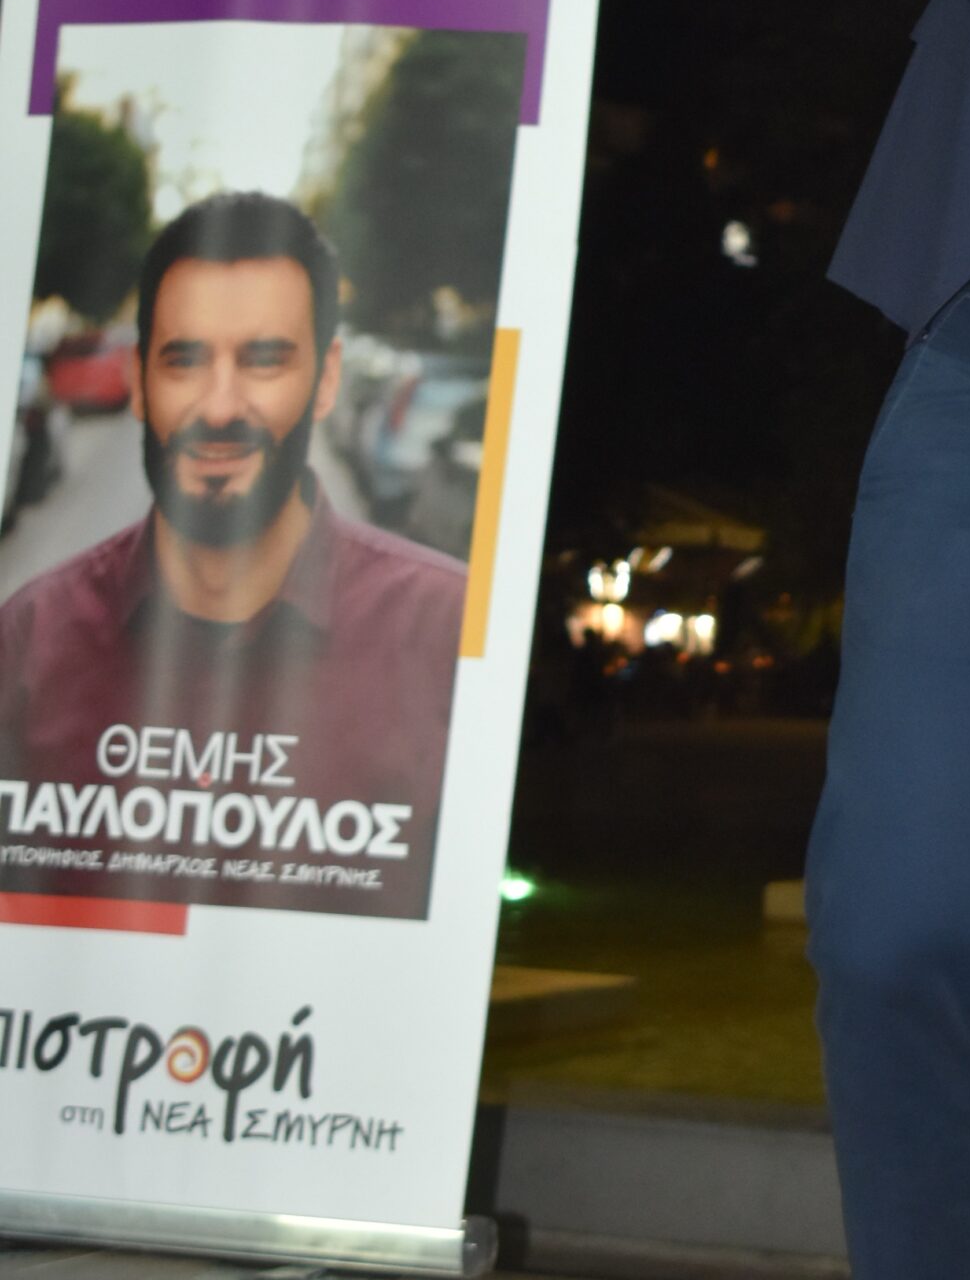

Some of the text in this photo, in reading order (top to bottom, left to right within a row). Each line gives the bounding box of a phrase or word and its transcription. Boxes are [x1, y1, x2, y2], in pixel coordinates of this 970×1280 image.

[97, 724, 299, 787] ΘΕΜΗΣ
[0, 779, 413, 858] ΠΑΥΛΟΠΟΥΛΟΣ
[221, 859, 276, 882] ΝΕΑΣ
[279, 862, 384, 891] ΣΜΥΡΝΗΣ
[139, 1100, 213, 1139] ΝΕΑ
[240, 1108, 405, 1153] ΣΜΥΡΝΗ
